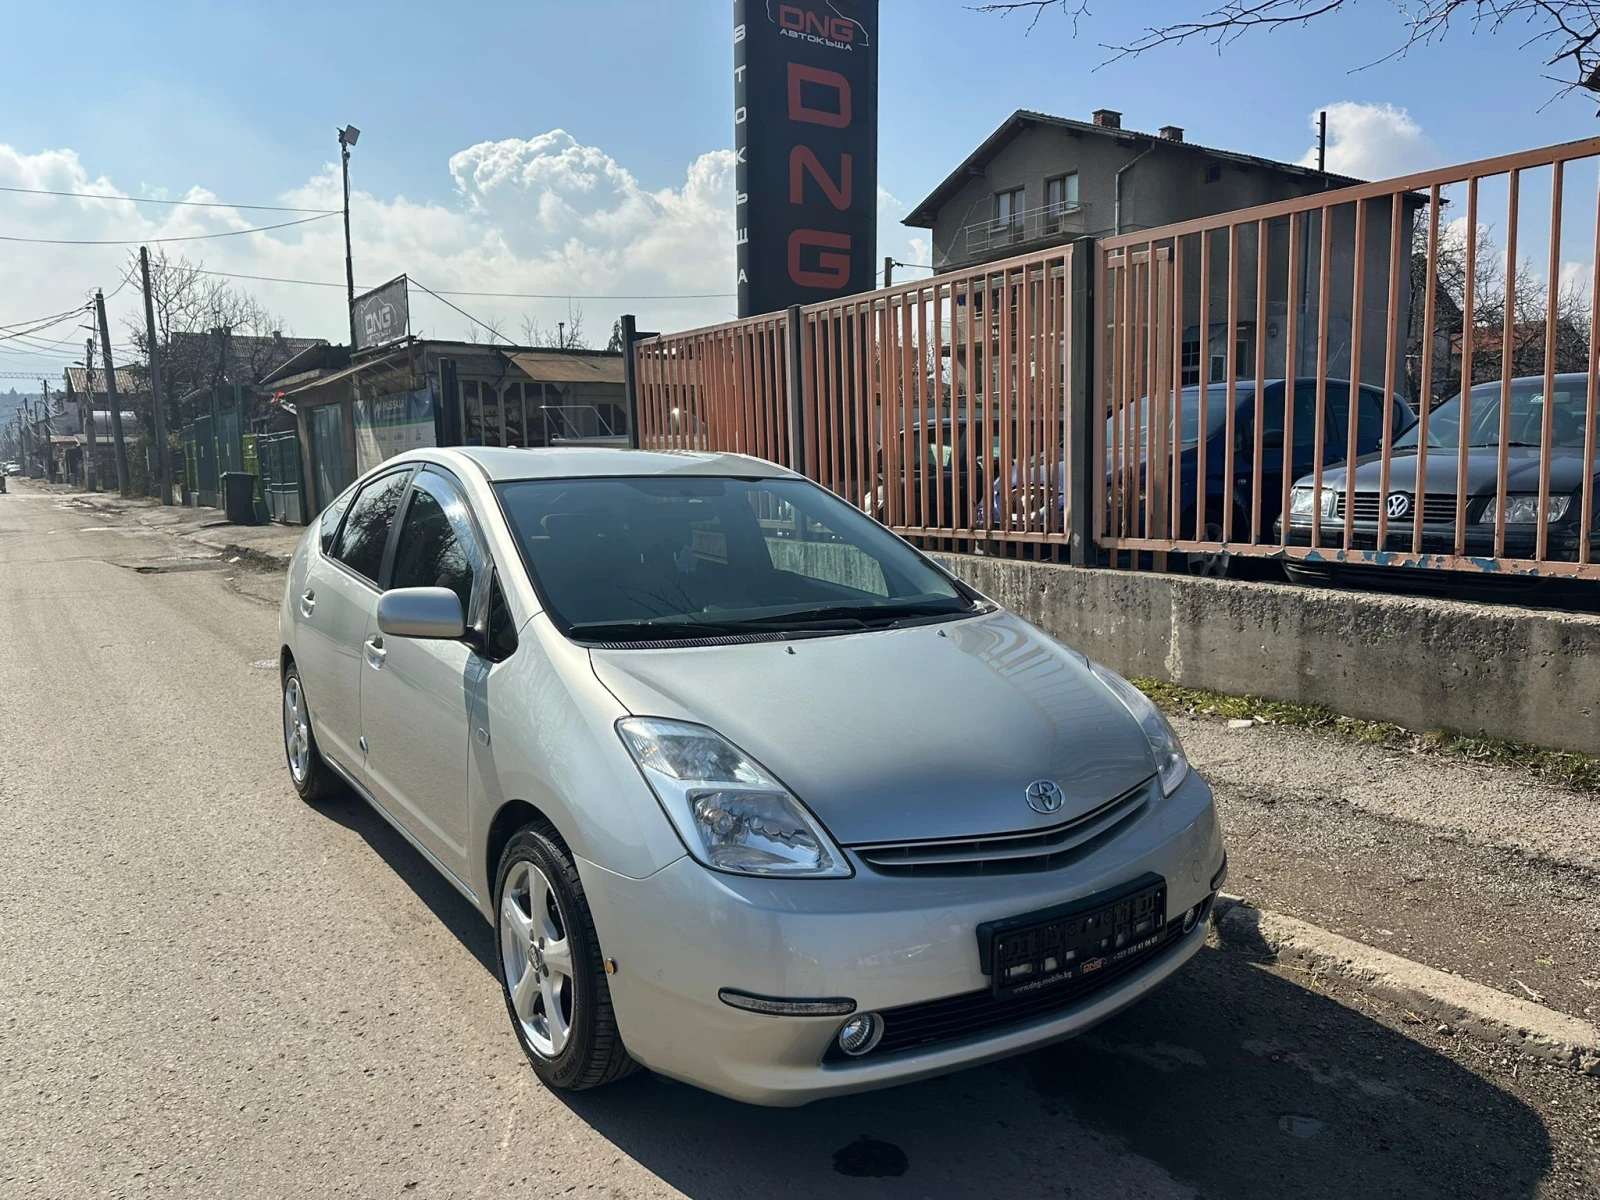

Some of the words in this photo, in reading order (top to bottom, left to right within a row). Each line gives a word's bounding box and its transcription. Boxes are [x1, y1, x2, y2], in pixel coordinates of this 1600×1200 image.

[779, 4, 854, 42] DNG
[779, 28, 853, 51] АВТОКЪЩА
[734, 0, 748, 284] ВТОКЪЩА
[787, 62, 853, 289] DNG
[365, 306, 391, 335] DNG
